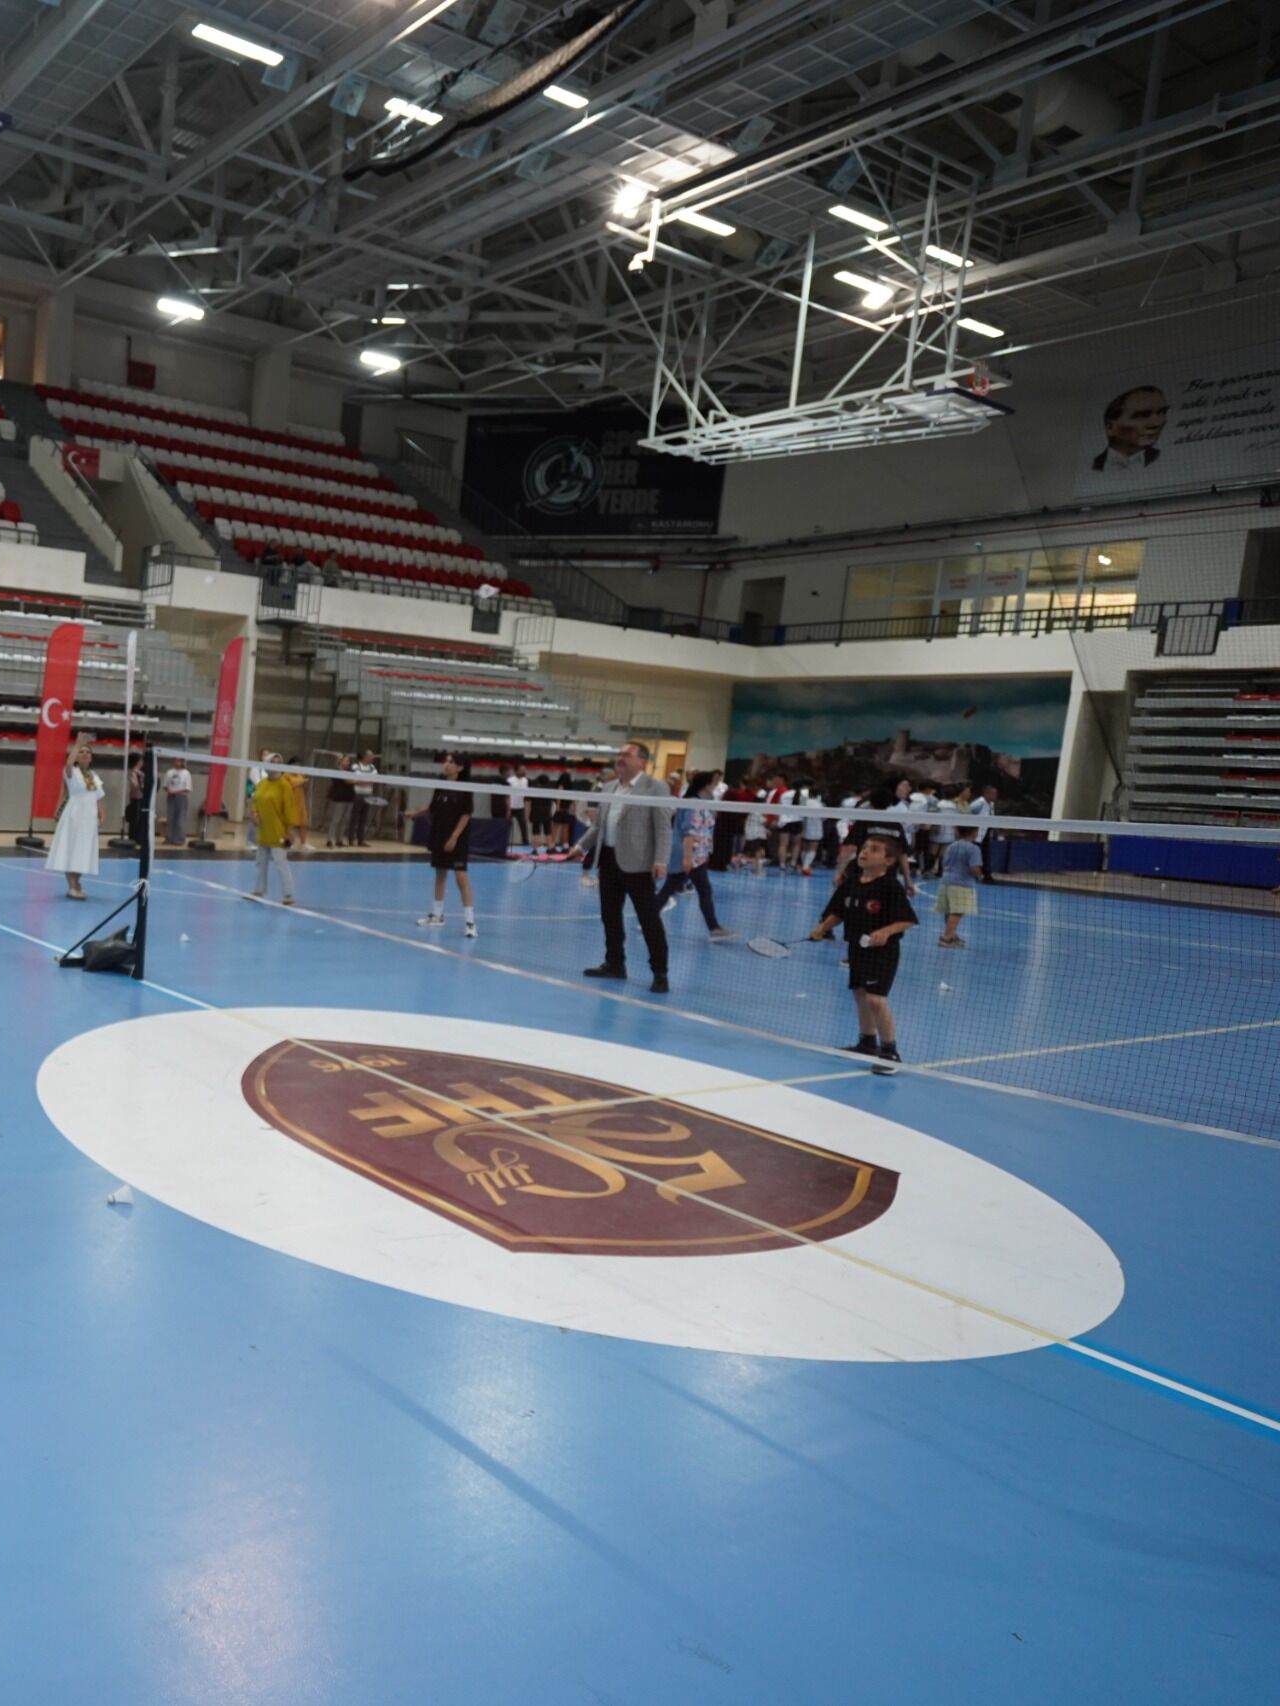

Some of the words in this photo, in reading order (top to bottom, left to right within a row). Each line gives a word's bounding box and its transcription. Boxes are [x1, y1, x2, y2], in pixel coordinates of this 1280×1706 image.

[603, 459, 639, 486] HER
[596, 488, 661, 515] YERDE
[349, 1076, 616, 1139] THF
